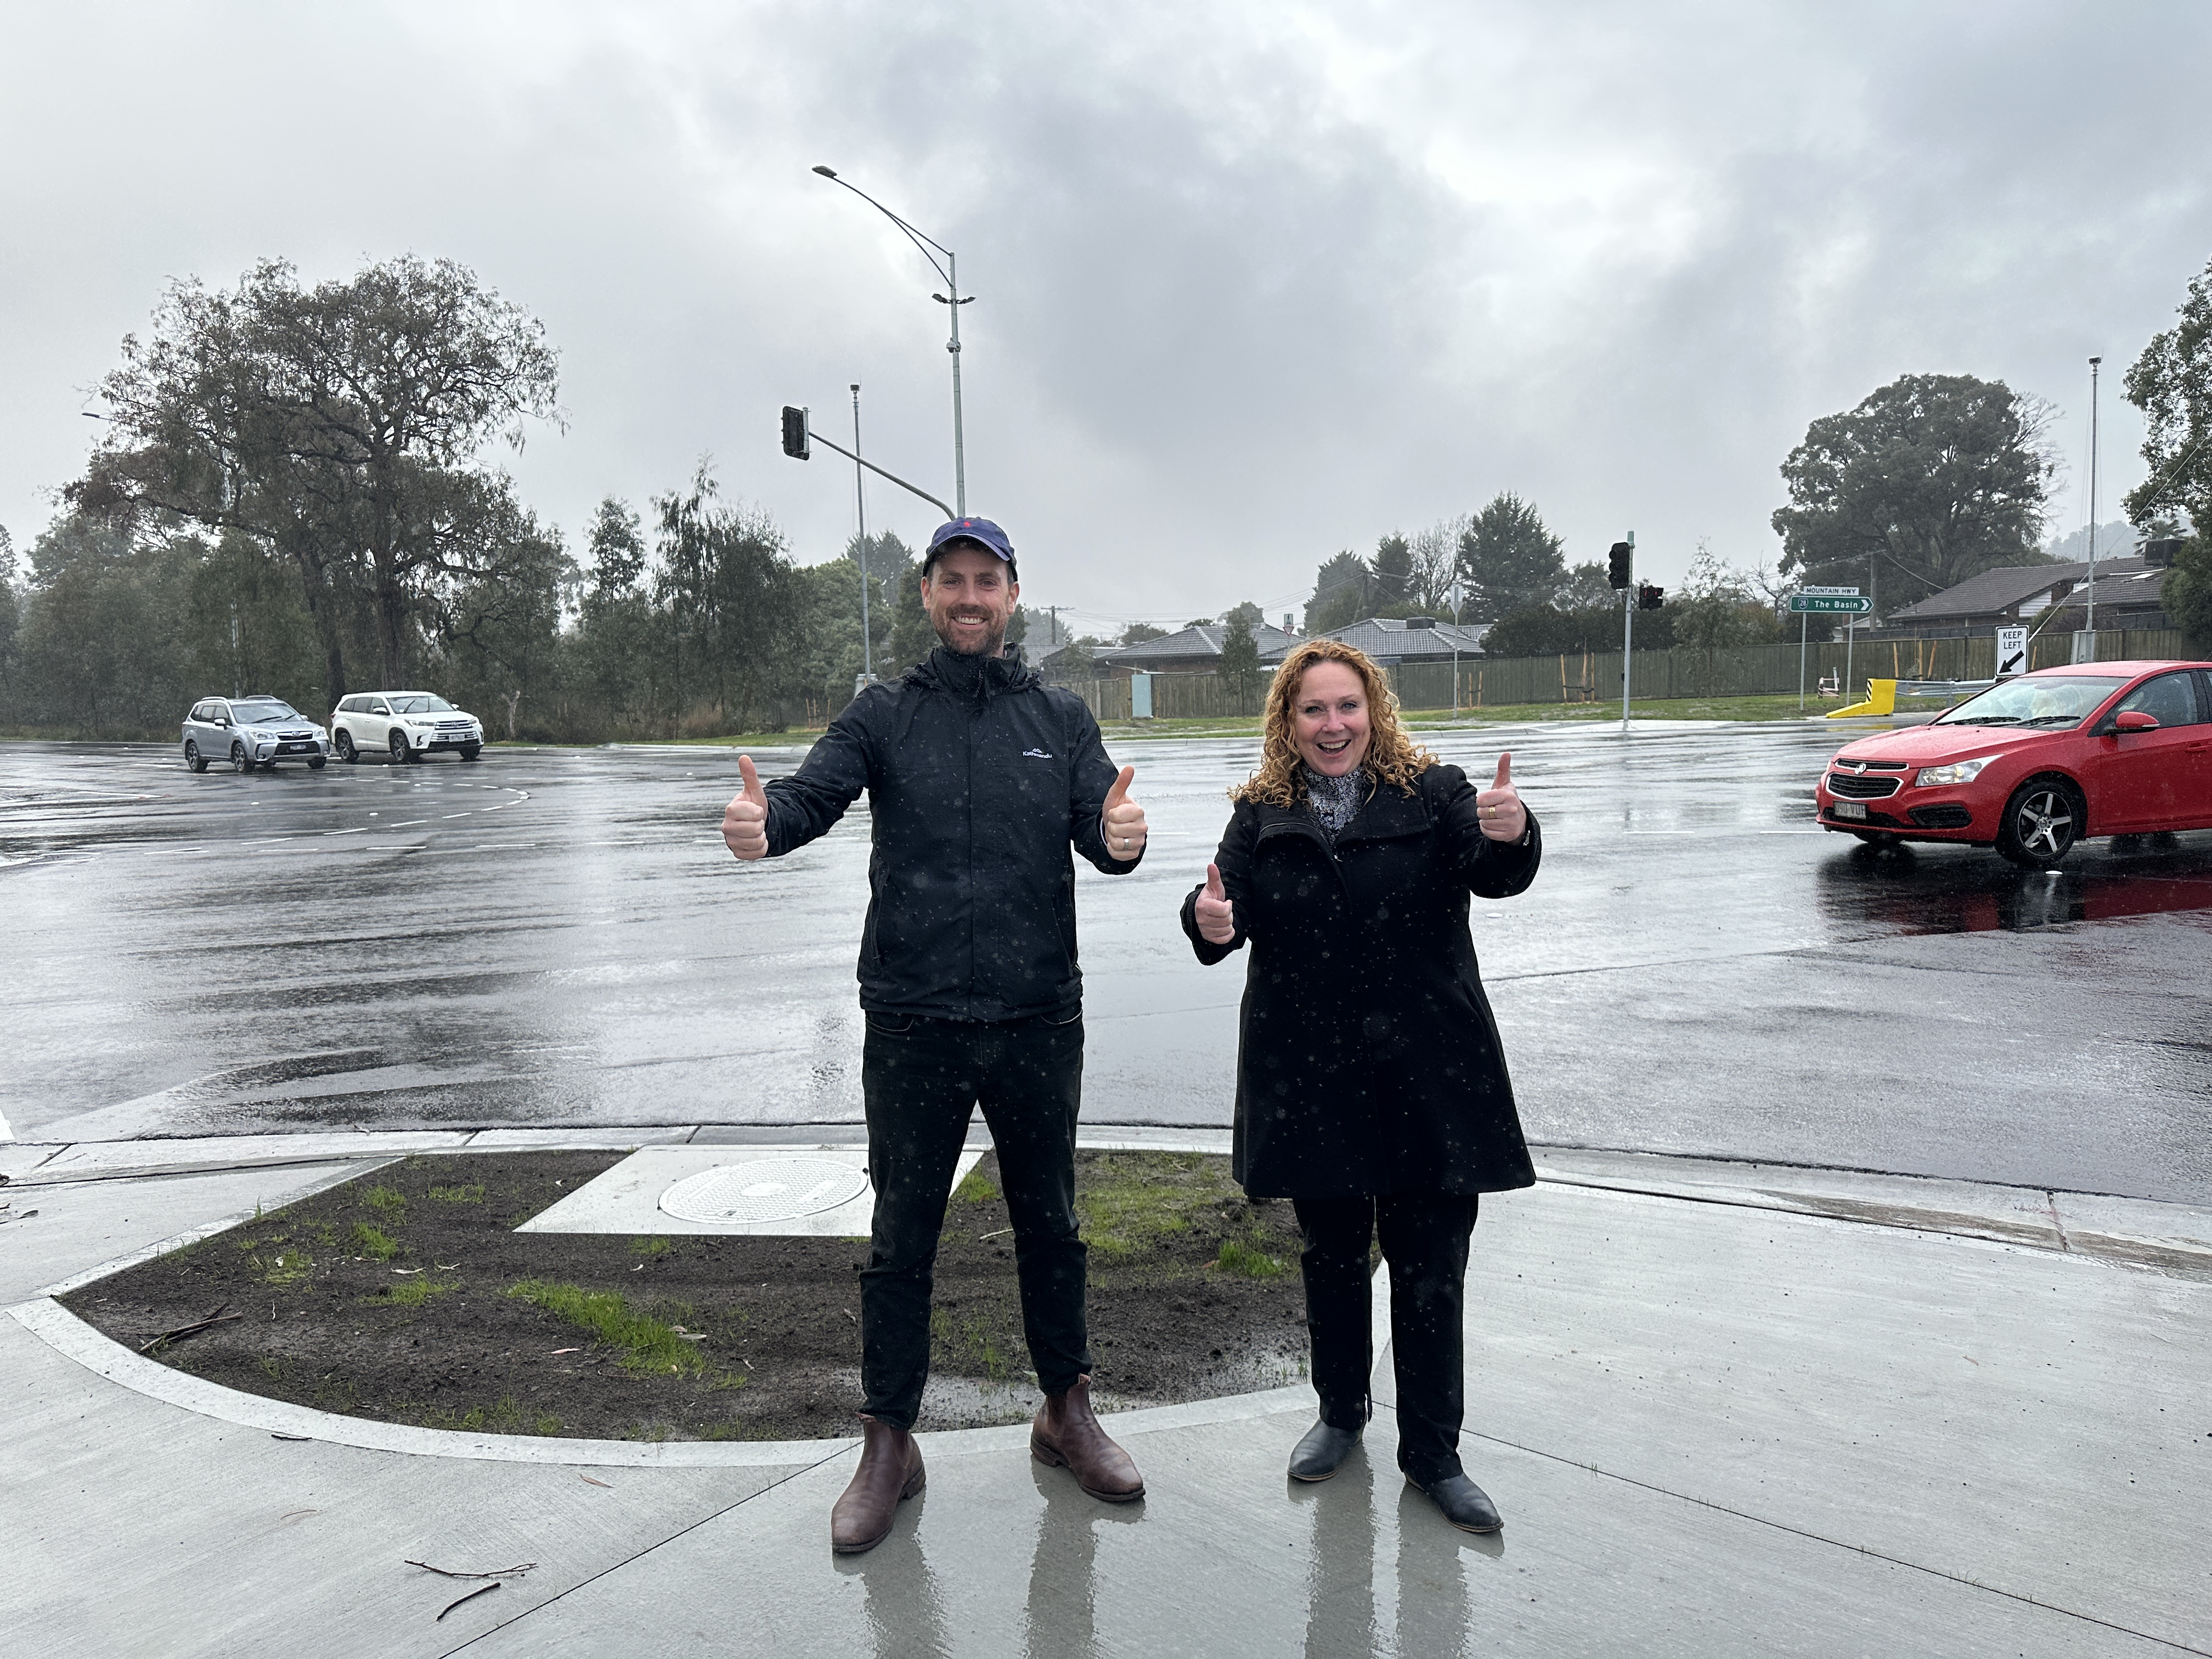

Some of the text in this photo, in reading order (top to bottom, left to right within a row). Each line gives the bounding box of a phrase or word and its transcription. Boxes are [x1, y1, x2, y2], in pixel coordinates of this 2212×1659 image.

[1834, 600, 1858, 608] Basin
[2003, 631, 2022, 639] KEEP
[2004, 641, 2022, 650] LEFT
[1023, 751, 1052, 759] Kathmandu
